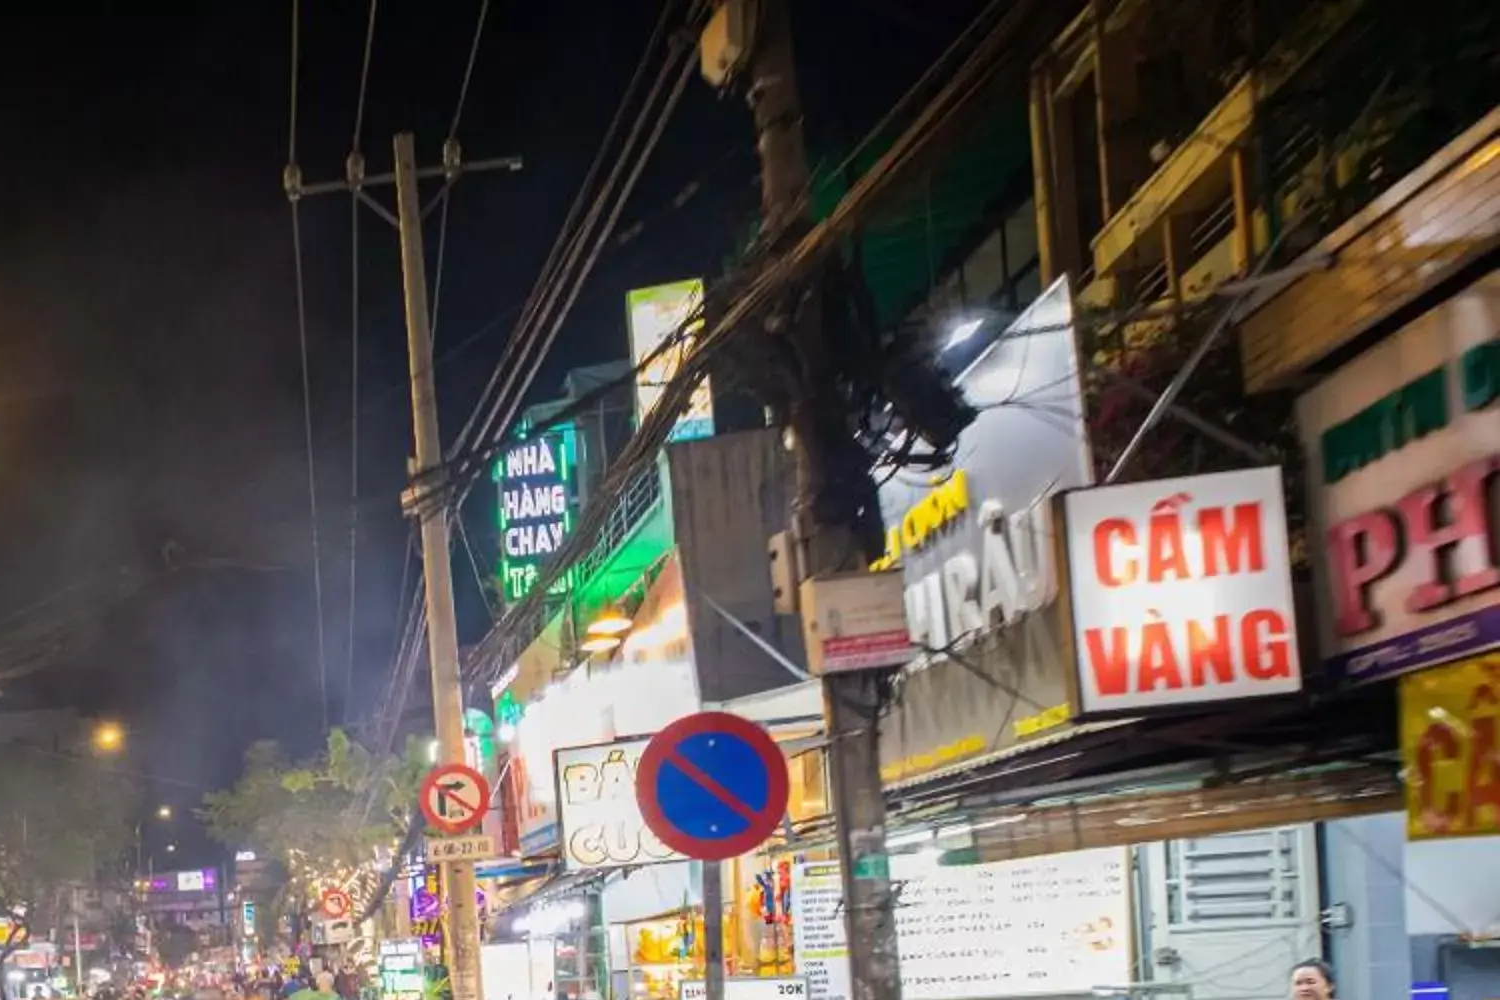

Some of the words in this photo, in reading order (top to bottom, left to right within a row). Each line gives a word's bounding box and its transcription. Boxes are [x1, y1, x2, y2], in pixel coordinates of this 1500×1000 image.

[506, 438, 556, 478] NHÀ
[503, 483, 566, 520] HÀNG
[505, 521, 564, 557] CHAY
[1084, 607, 1292, 697] VÀNG
[778, 984, 804, 995] 20K
